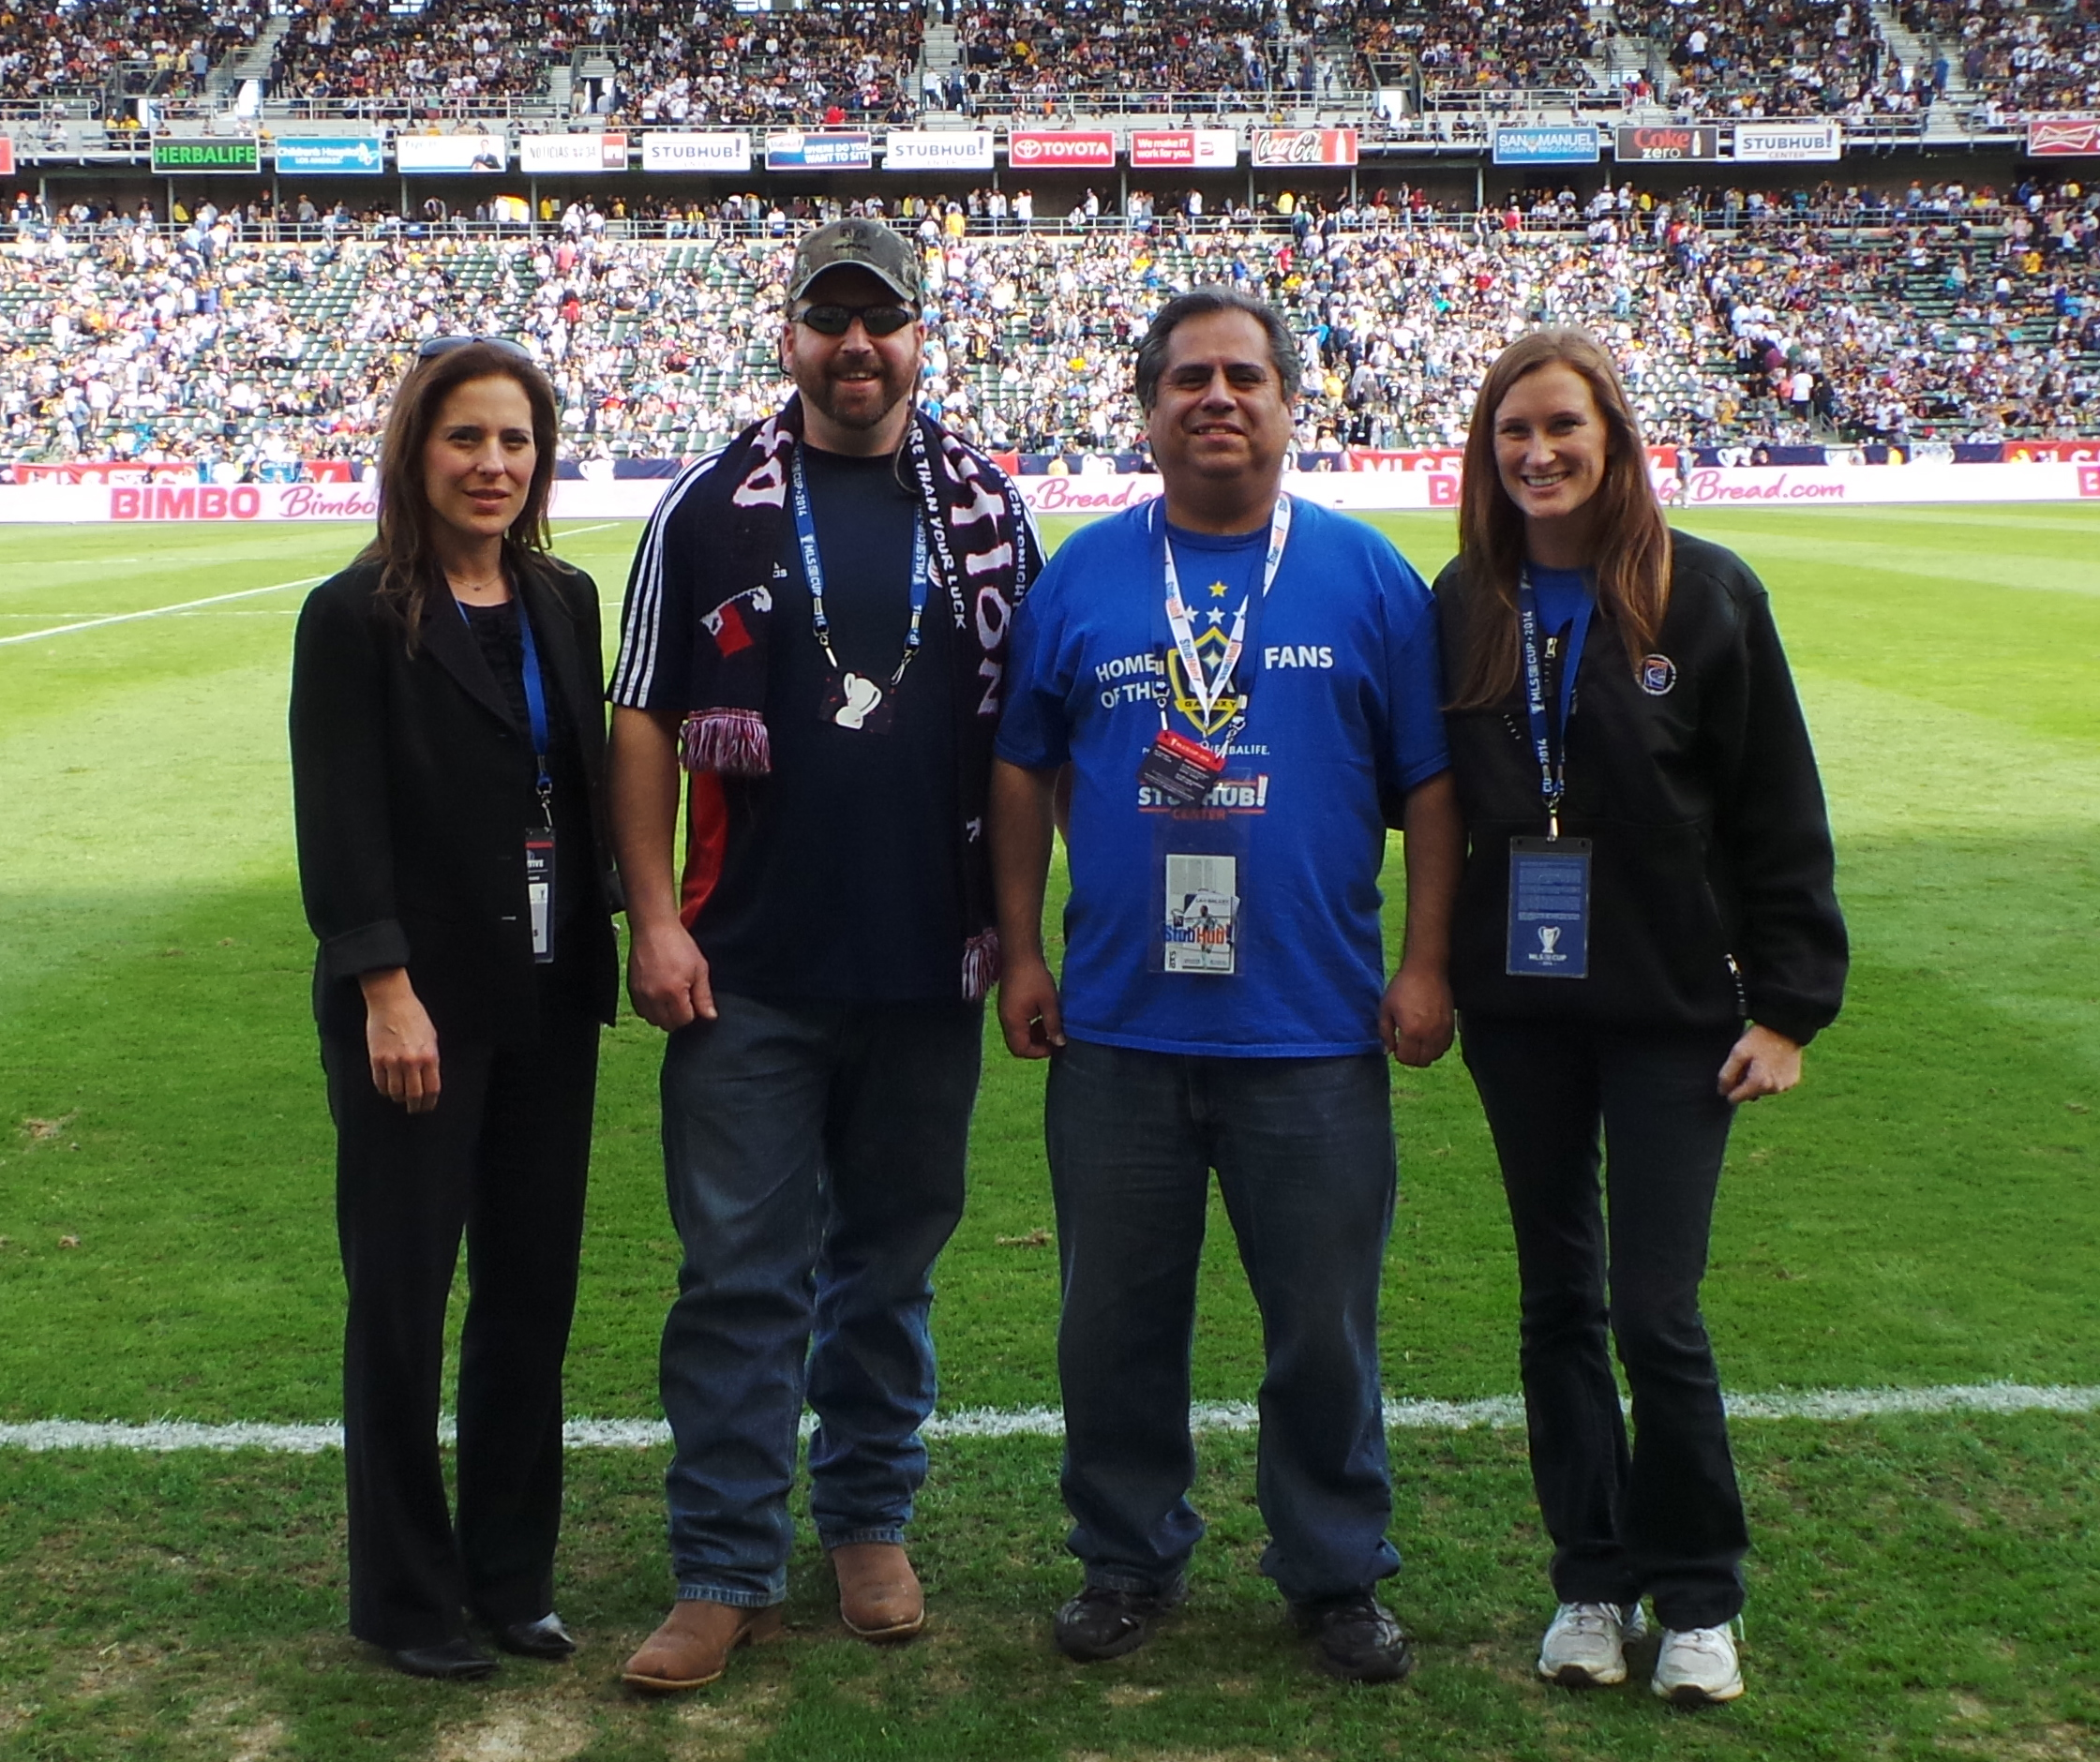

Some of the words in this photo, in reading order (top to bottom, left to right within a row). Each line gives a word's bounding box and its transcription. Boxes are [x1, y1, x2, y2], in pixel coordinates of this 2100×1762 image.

[652, 138, 741, 158] STUBHUB!
[804, 143, 834, 154] WHERE
[835, 142, 850, 153] DO
[850, 142, 869, 152] YOU
[895, 136, 984, 157] STUBHUB!
[1137, 139, 1153, 148] We
[1153, 138, 1178, 148] make
[1499, 134, 1528, 146] SAN
[1538, 134, 1595, 146] MANUEL
[1633, 127, 1689, 149] Coke
[1743, 128, 1832, 150] STUBHUB!
[155, 145, 258, 164] HERBALIFE
[805, 153, 834, 164] WANT
[834, 152, 848, 162] TO
[1042, 142, 1109, 157] TOYOTA
[1137, 149, 1159, 159] work
[1160, 149, 1172, 159] for
[1642, 148, 1680, 159] zero
[1768, 150, 1805, 159] CENTER
[111, 486, 261, 520] BIMBO
[794, 495, 808, 517] 2014
[803, 545, 818, 564] MLS
[915, 458, 939, 513] THAN
[929, 516, 955, 572] YOUR
[947, 575, 967, 630] LUCK
[915, 553, 926, 575] MLS
[810, 577, 823, 597] CUP
[1522, 611, 1534, 636] 2014
[1095, 652, 1156, 683] HOME
[1264, 645, 1333, 670] FANS
[1179, 638, 1202, 681] StubHub!
[1525, 643, 1538, 664] CUP
[1100, 689, 1120, 709] OF
[1529, 678, 1542, 702] MLS
[1538, 738, 1550, 764] 2014
[1138, 774, 1268, 807] STHUB!
